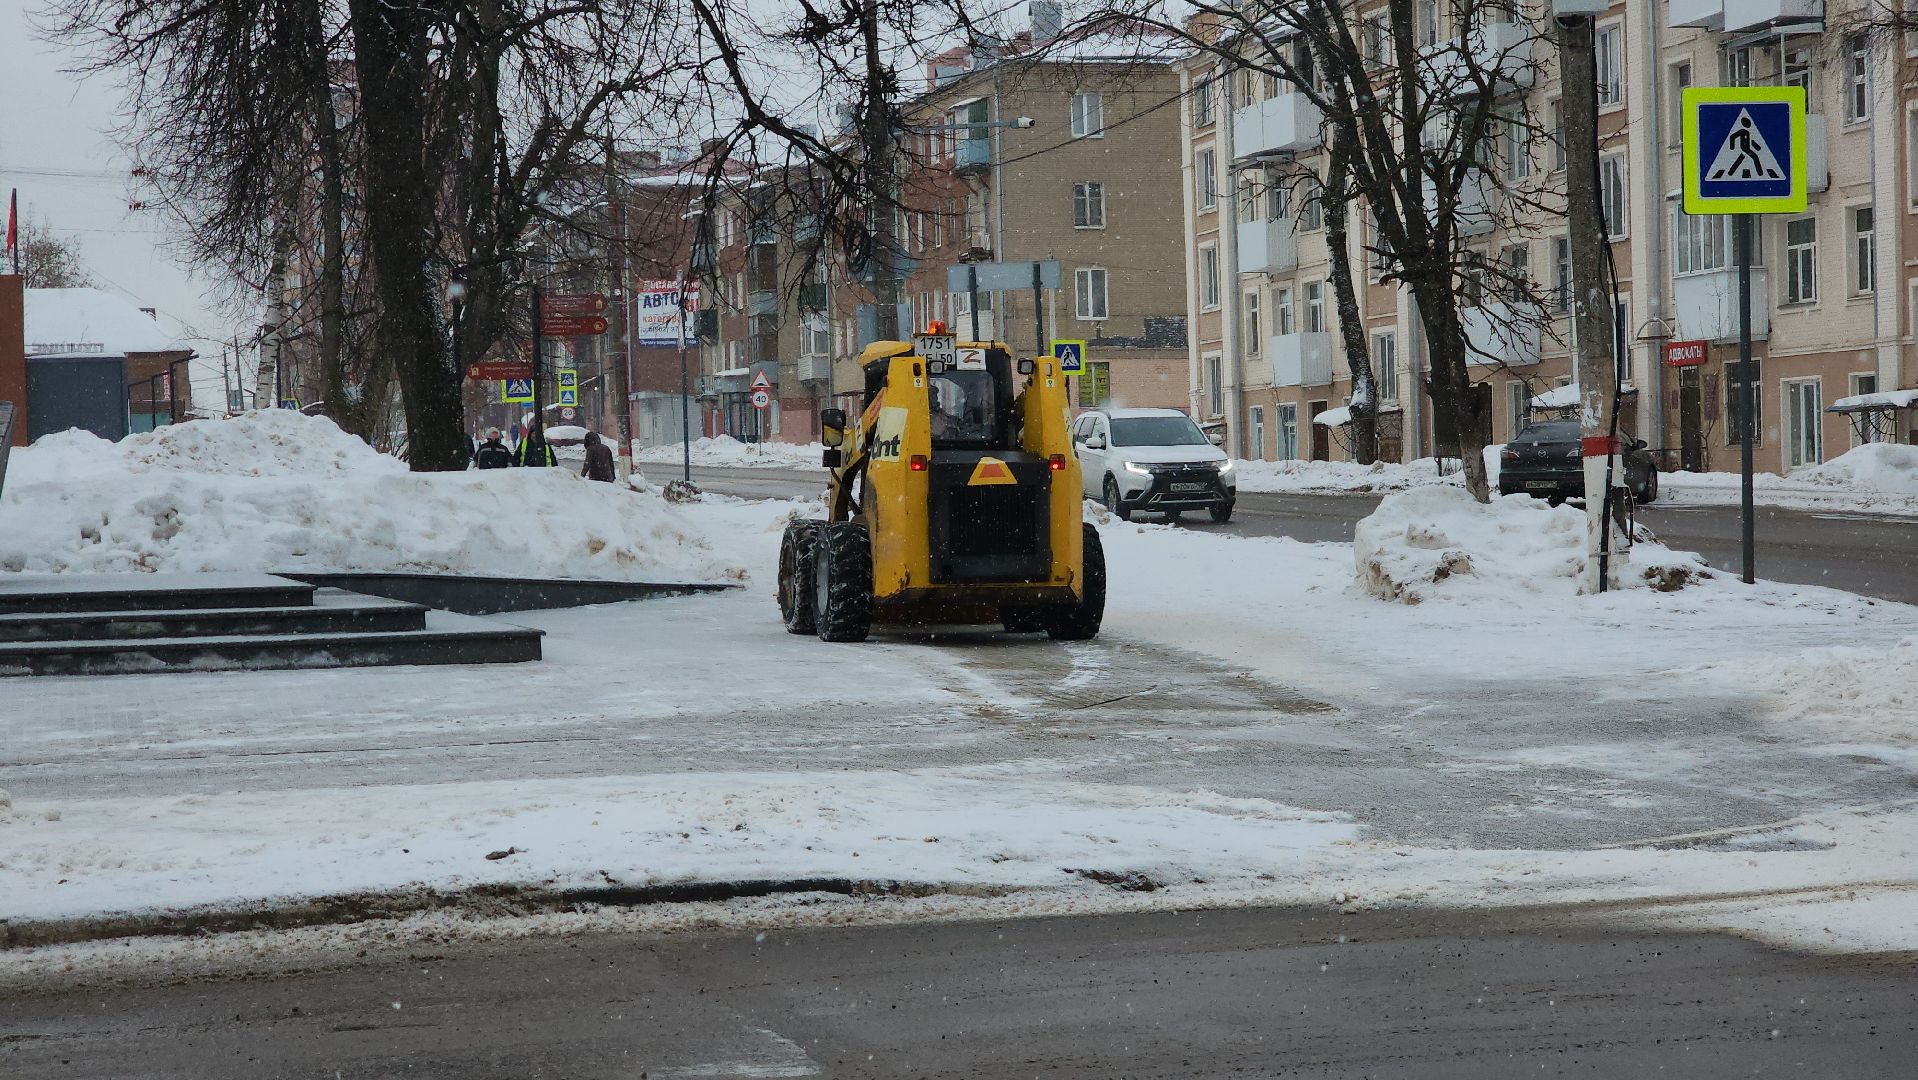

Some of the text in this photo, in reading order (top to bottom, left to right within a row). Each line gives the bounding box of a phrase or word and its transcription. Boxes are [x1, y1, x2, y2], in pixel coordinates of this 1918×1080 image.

[920, 337, 950, 349] 1751
[940, 353, 952, 363] 50
[961, 349, 981, 363] Z
[1668, 345, 1702, 361] АДВОКАТЫ
